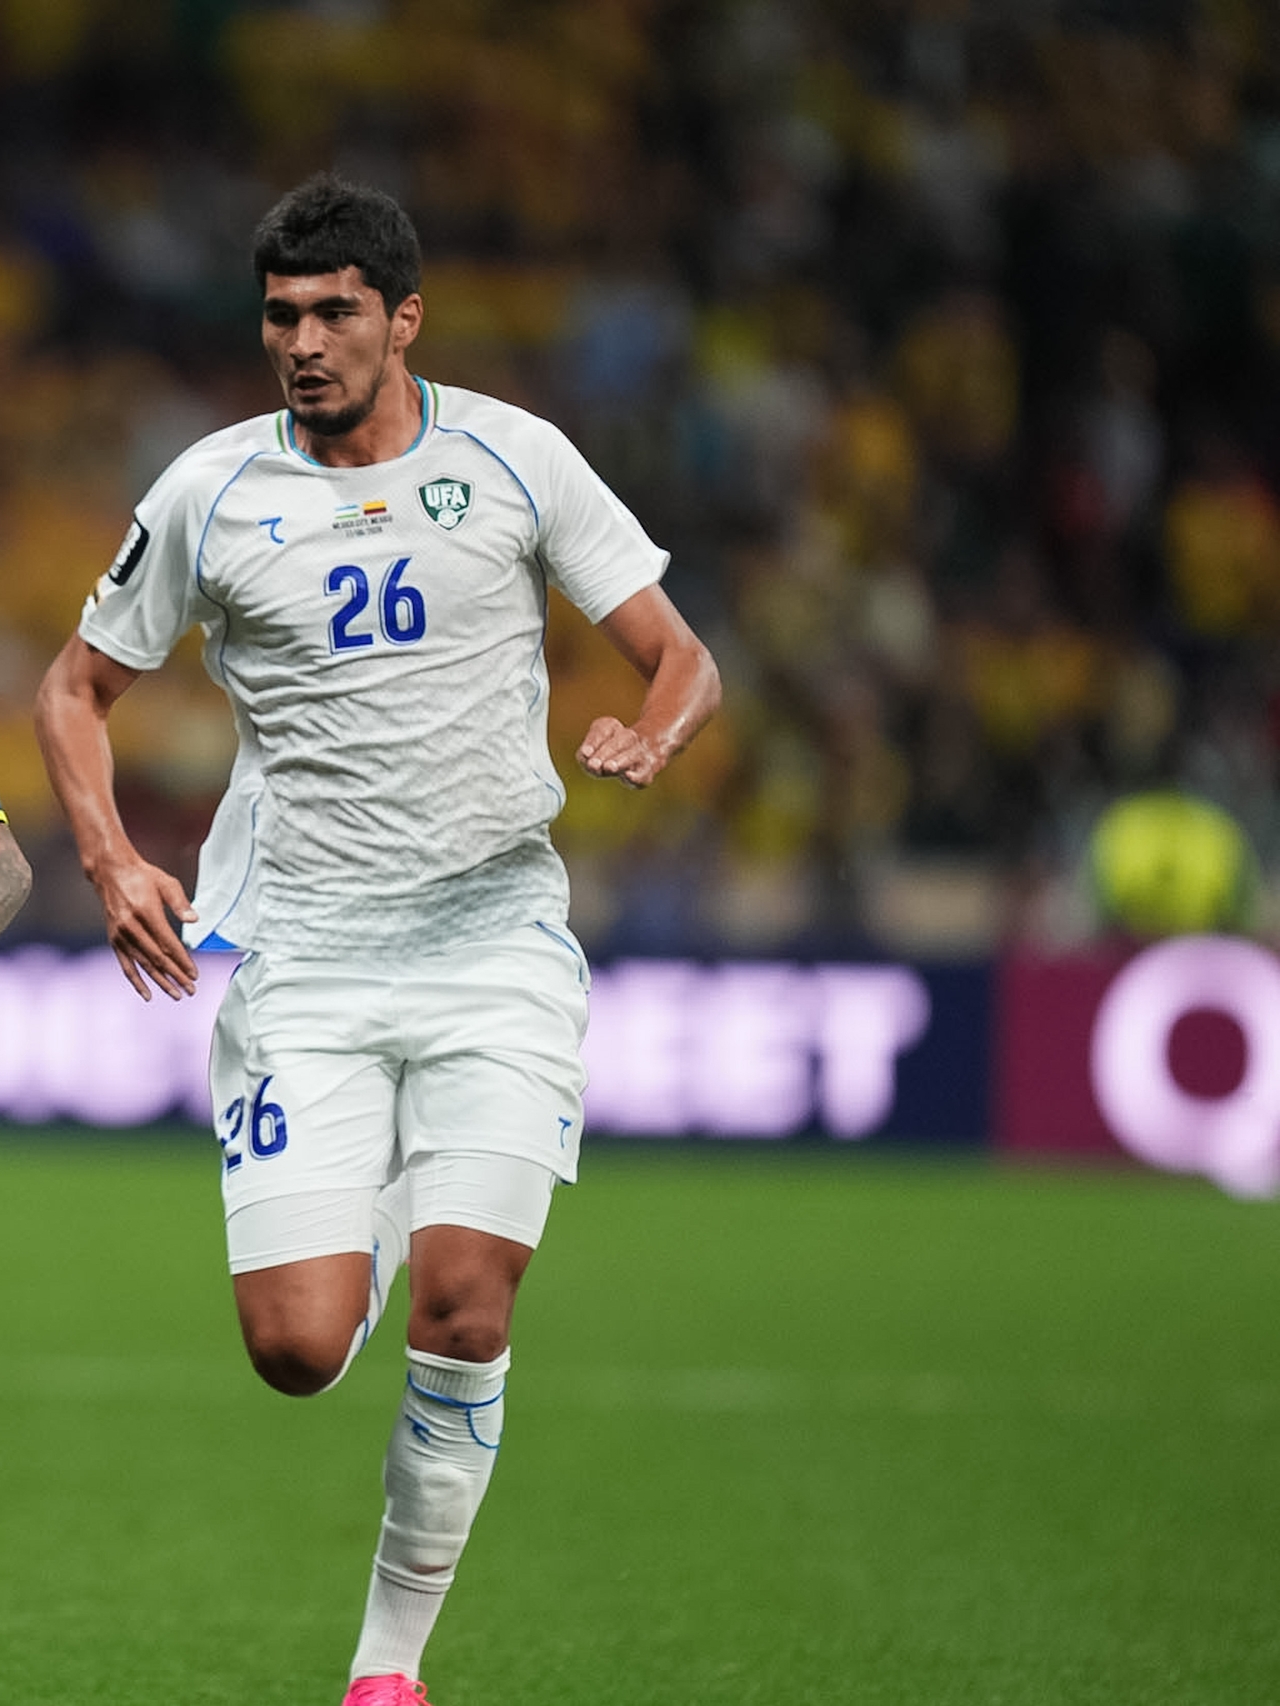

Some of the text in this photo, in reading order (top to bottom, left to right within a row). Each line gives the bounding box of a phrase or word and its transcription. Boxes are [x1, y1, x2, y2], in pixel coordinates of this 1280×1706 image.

[424, 483, 468, 508] UFA
[324, 556, 426, 655] 26
[219, 1073, 288, 1174] 26
